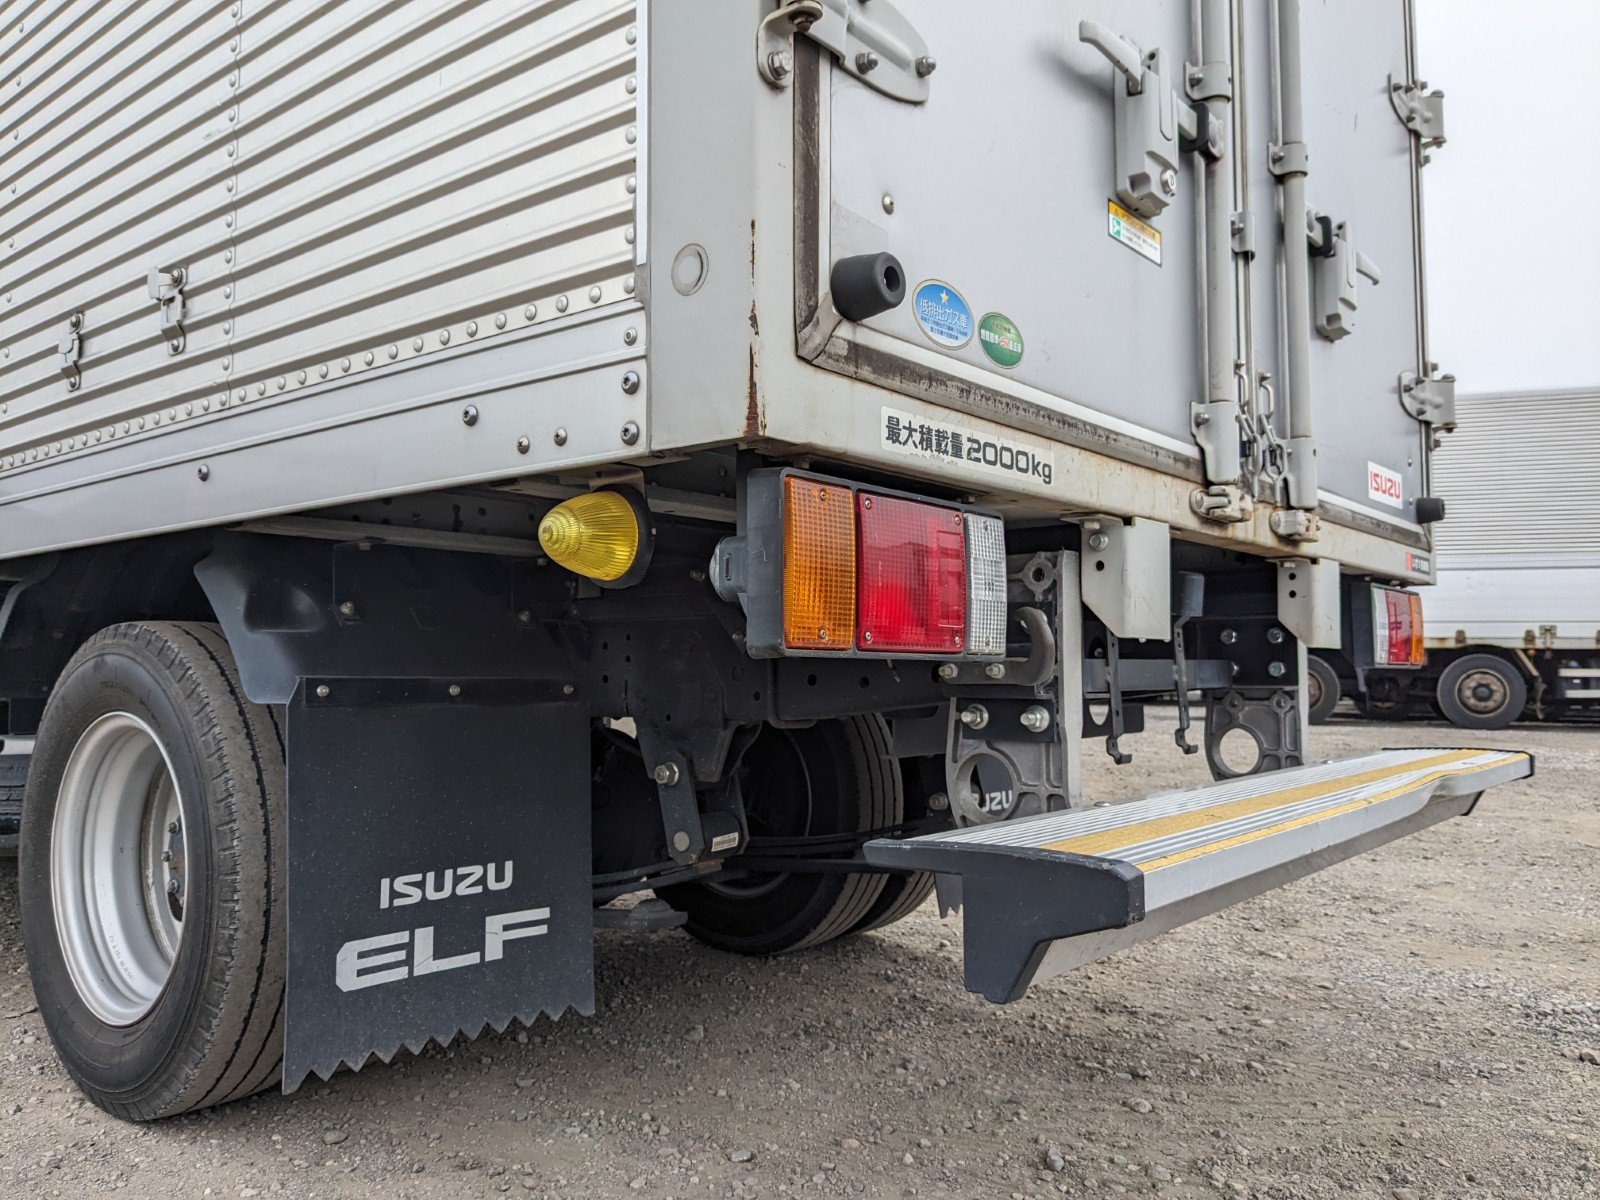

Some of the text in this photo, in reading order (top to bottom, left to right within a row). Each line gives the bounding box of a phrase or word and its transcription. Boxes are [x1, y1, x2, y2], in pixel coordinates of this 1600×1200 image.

[1370, 471, 1401, 499] ISUZU
[380, 860, 513, 909] ISUZU
[336, 907, 550, 992] ELF
